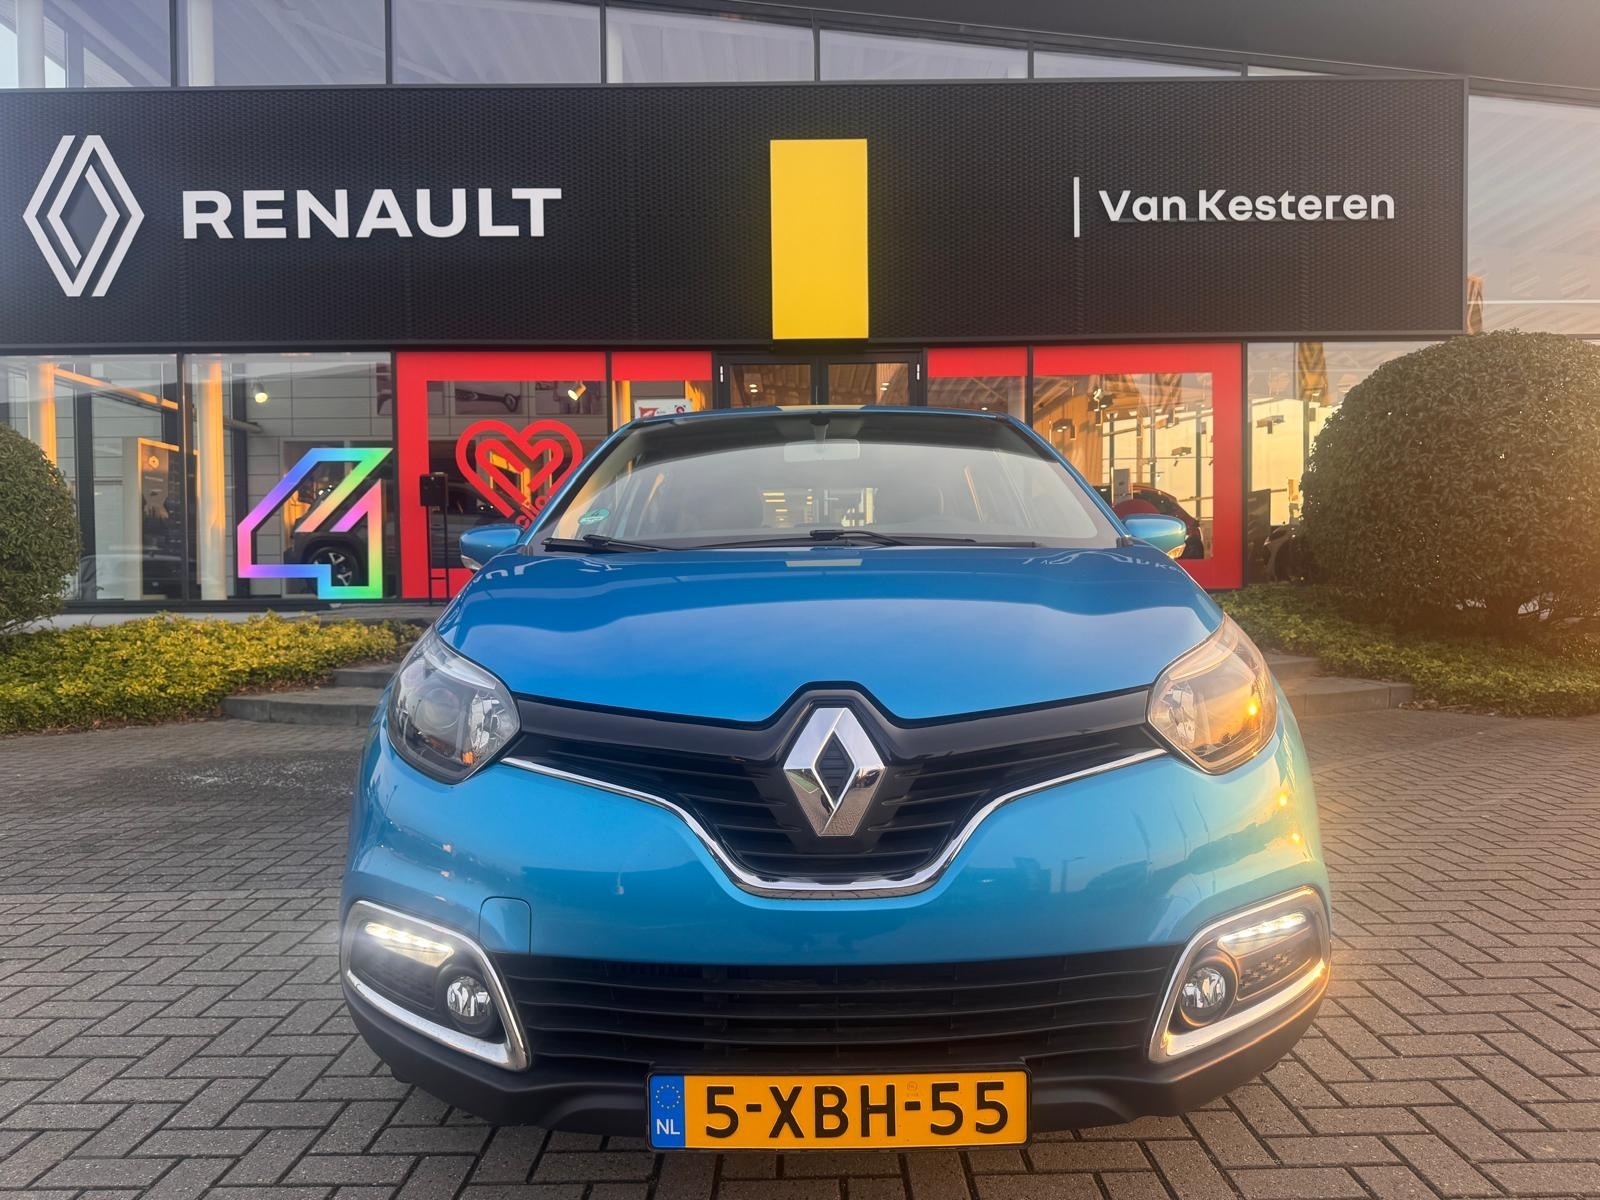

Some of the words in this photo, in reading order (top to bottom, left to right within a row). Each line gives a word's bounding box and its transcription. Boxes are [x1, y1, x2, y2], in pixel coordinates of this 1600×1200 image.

[182, 188, 562, 239] RENAULT
[1099, 190, 1186, 221] Van
[1199, 189, 1395, 221] Kesteren
[656, 1119, 680, 1135] NL
[705, 1080, 1008, 1139] 5-XBH-55
